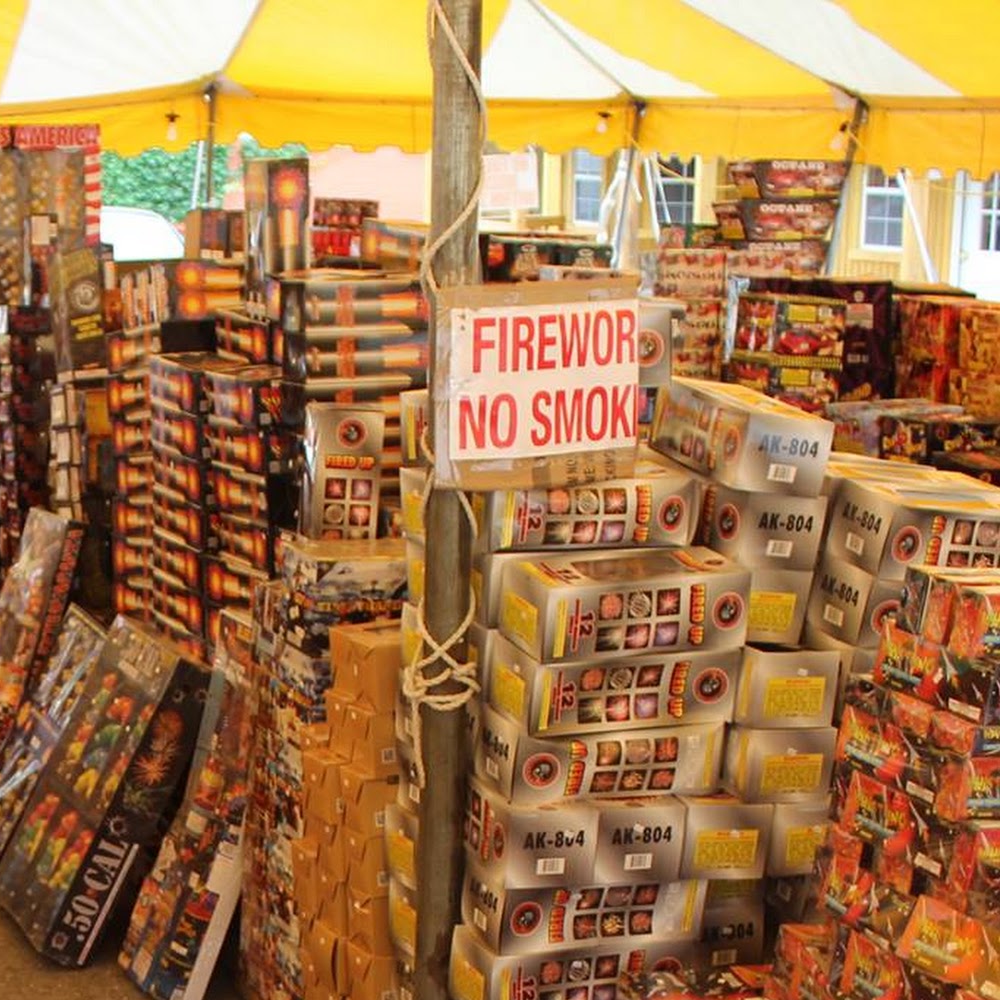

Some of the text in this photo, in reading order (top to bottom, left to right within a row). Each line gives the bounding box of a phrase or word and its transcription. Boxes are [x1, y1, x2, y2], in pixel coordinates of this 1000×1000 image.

[472, 309, 636, 373] FIREWOR
[458, 393, 518, 450] NO
[758, 434, 820, 458] AK-804
[758, 512, 814, 533] AK-804
[842, 502, 883, 535] AK-804
[820, 573, 860, 607] AK-804
[579, 612, 596, 636] 12
[561, 683, 577, 708] 12
[612, 826, 673, 846] AK-804
[83, 837, 132, 891] CAL
